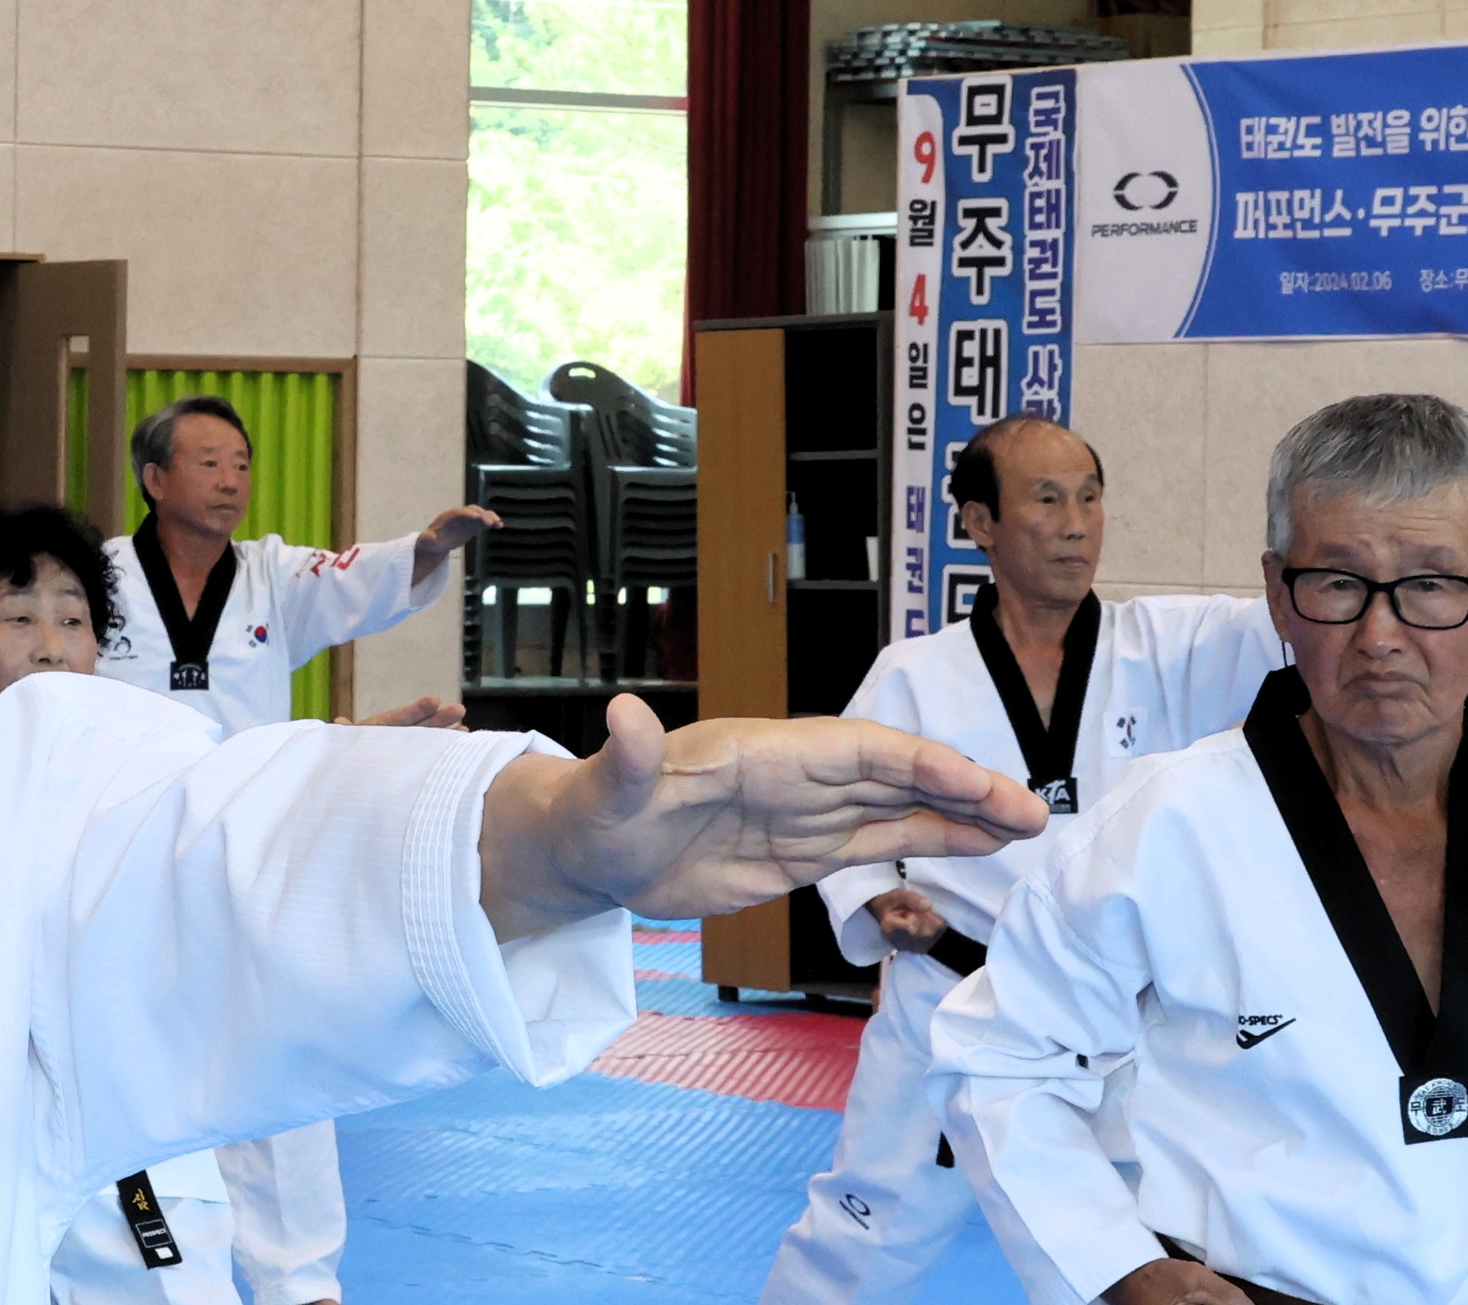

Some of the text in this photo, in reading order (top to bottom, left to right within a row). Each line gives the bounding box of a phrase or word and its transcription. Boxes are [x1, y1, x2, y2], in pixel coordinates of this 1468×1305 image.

[1239, 114, 1323, 161] 태권도
[1329, 108, 1413, 158] 발전을
[1023, 87, 1066, 335] 국제태권도
[1091, 219, 1198, 238] PERFORMANCE
